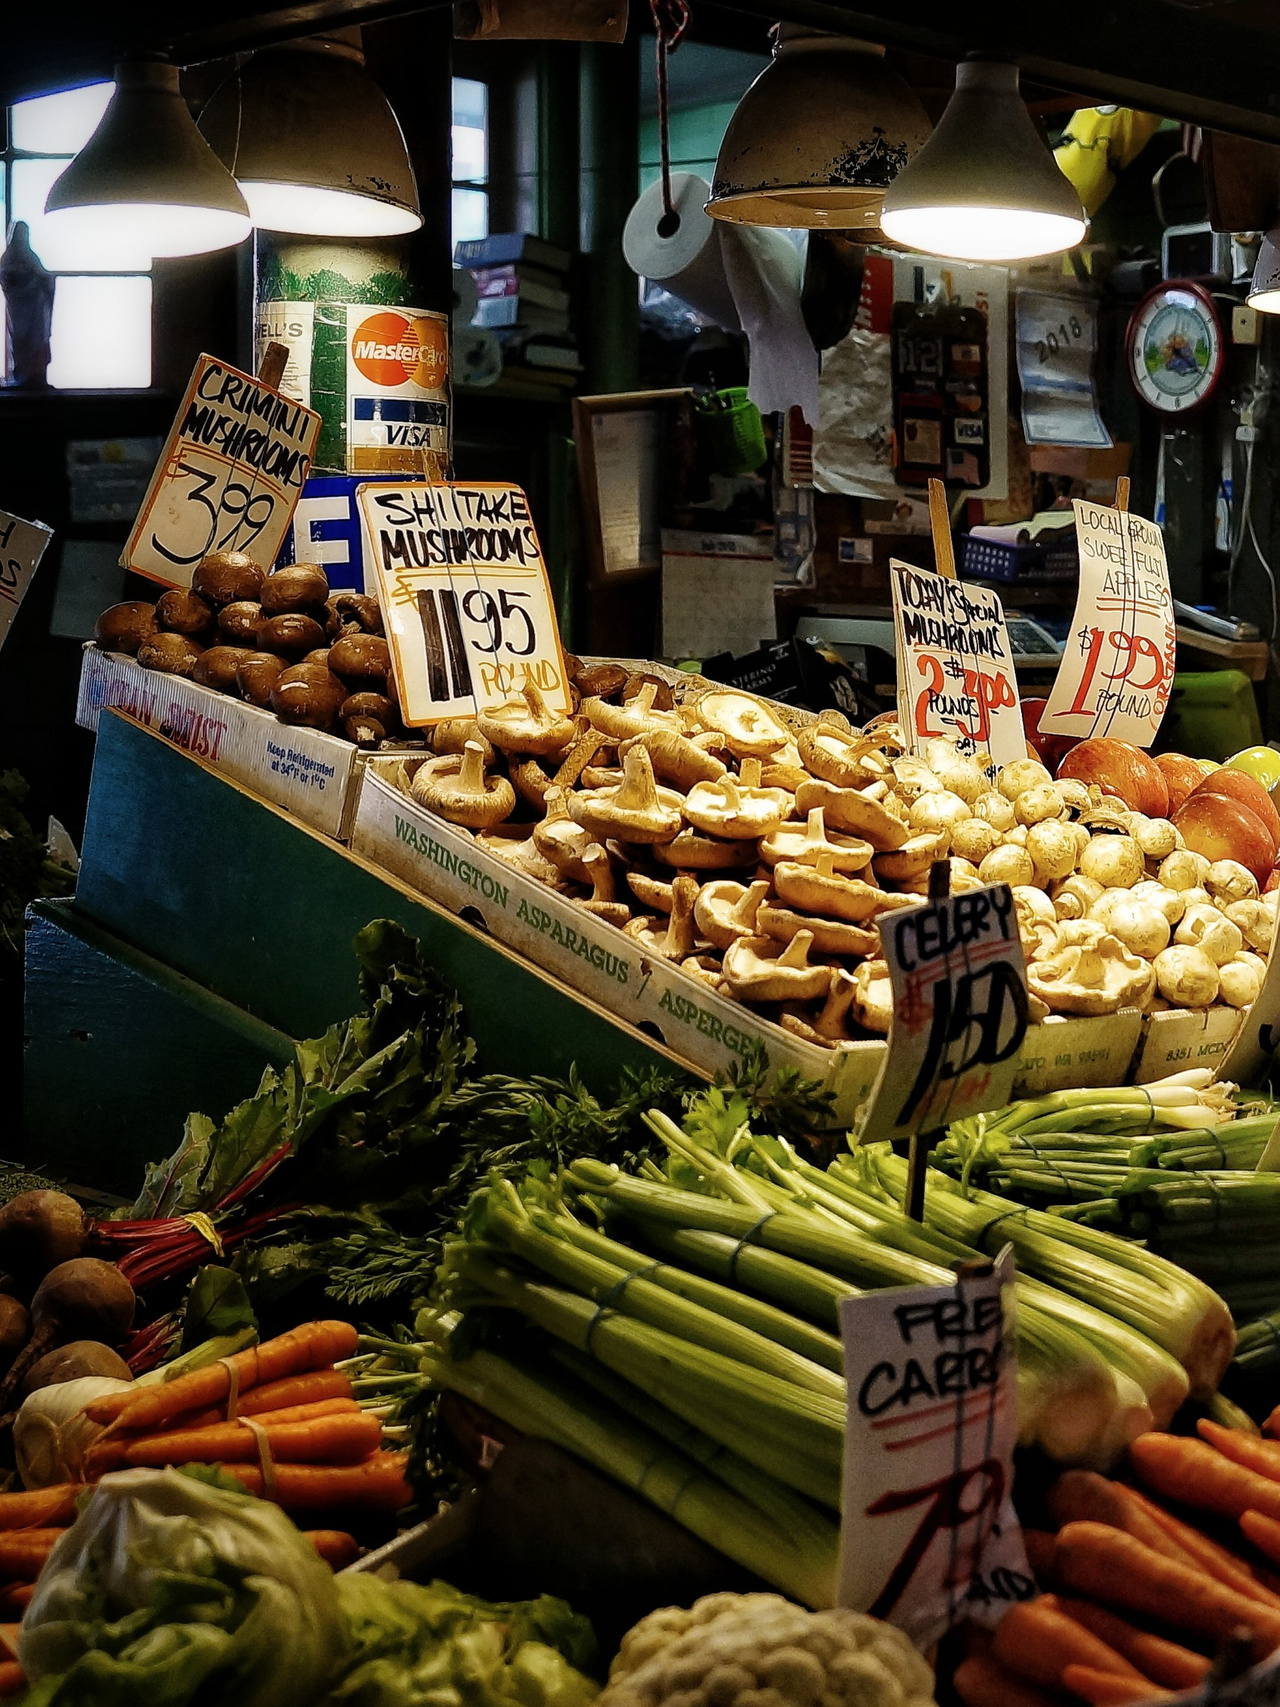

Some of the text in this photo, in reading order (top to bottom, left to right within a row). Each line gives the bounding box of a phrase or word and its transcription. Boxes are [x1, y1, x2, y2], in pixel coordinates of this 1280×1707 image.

[257, 322, 303, 338] ELL'S
[1035, 315, 1083, 364] 2018
[354, 340, 447, 366] MasterCard
[197, 364, 310, 442] CRIMINI
[178, 402, 311, 488] MUSHROOMS
[385, 424, 432, 447] VISA
[374, 490, 530, 528] SHIITAKE
[1079, 506, 1125, 537] LOCAL
[379, 526, 541, 570] MUSHROOMS
[1133, 550, 1165, 581] FUJI
[1102, 568, 1169, 607] APPLES
[902, 609, 1006, 660] MUSHROOMS
[1096, 688, 1152, 719] POUND
[266, 739, 335, 778] Keep Refrigerated
[393, 814, 510, 908] WASHINGTON
[515, 898, 630, 984] ASPARAGUS
[658, 987, 757, 1062] ASPERGE
[895, 885, 1013, 972] CELERY
[894, 1296, 1003, 1342] FRE
[858, 1341, 1003, 1417] CARR
